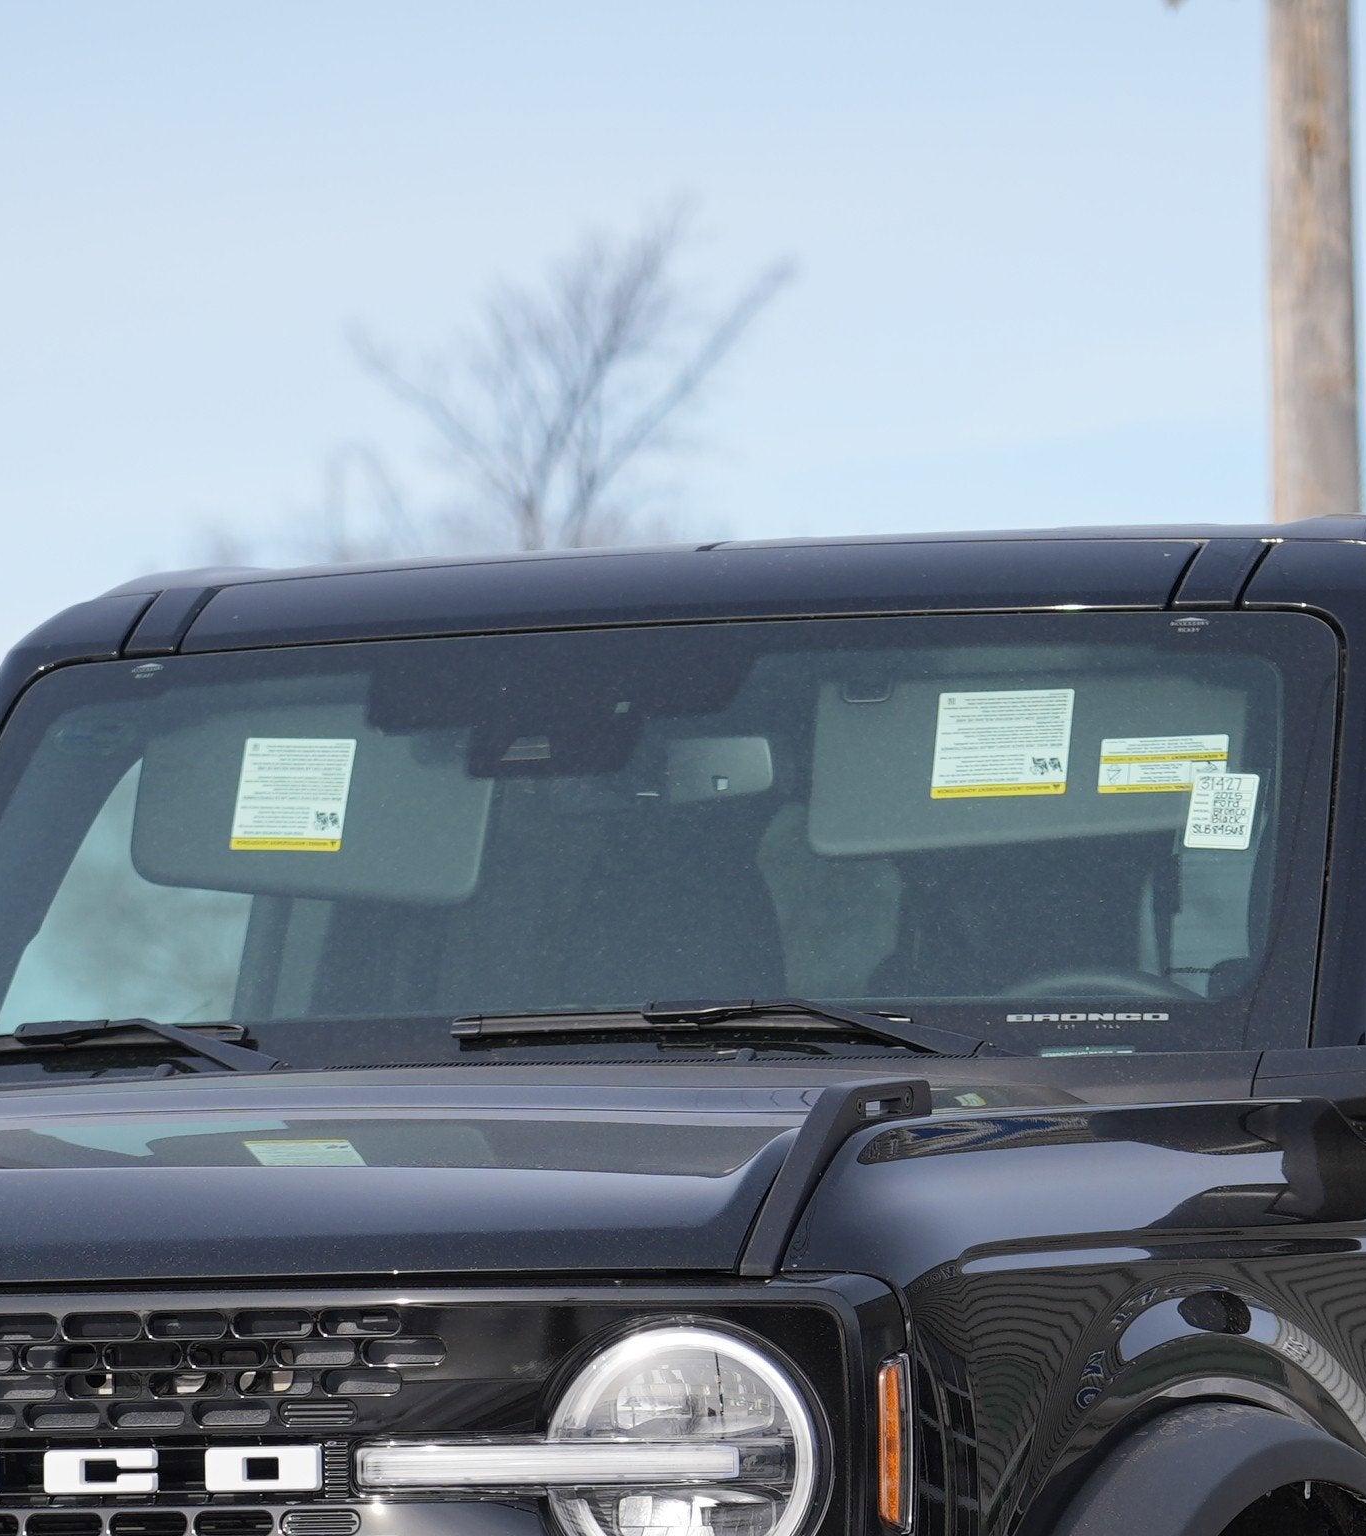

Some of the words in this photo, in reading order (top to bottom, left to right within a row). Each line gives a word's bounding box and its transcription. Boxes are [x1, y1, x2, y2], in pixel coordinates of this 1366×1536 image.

[1200, 776, 1243, 791] 31427
[1214, 791, 1243, 801] 2025
[1213, 799, 1240, 808] Ford
[1213, 808, 1247, 817] Bronco
[1211, 815, 1242, 824] Black
[1006, 1013, 1170, 1023] BRONCO
